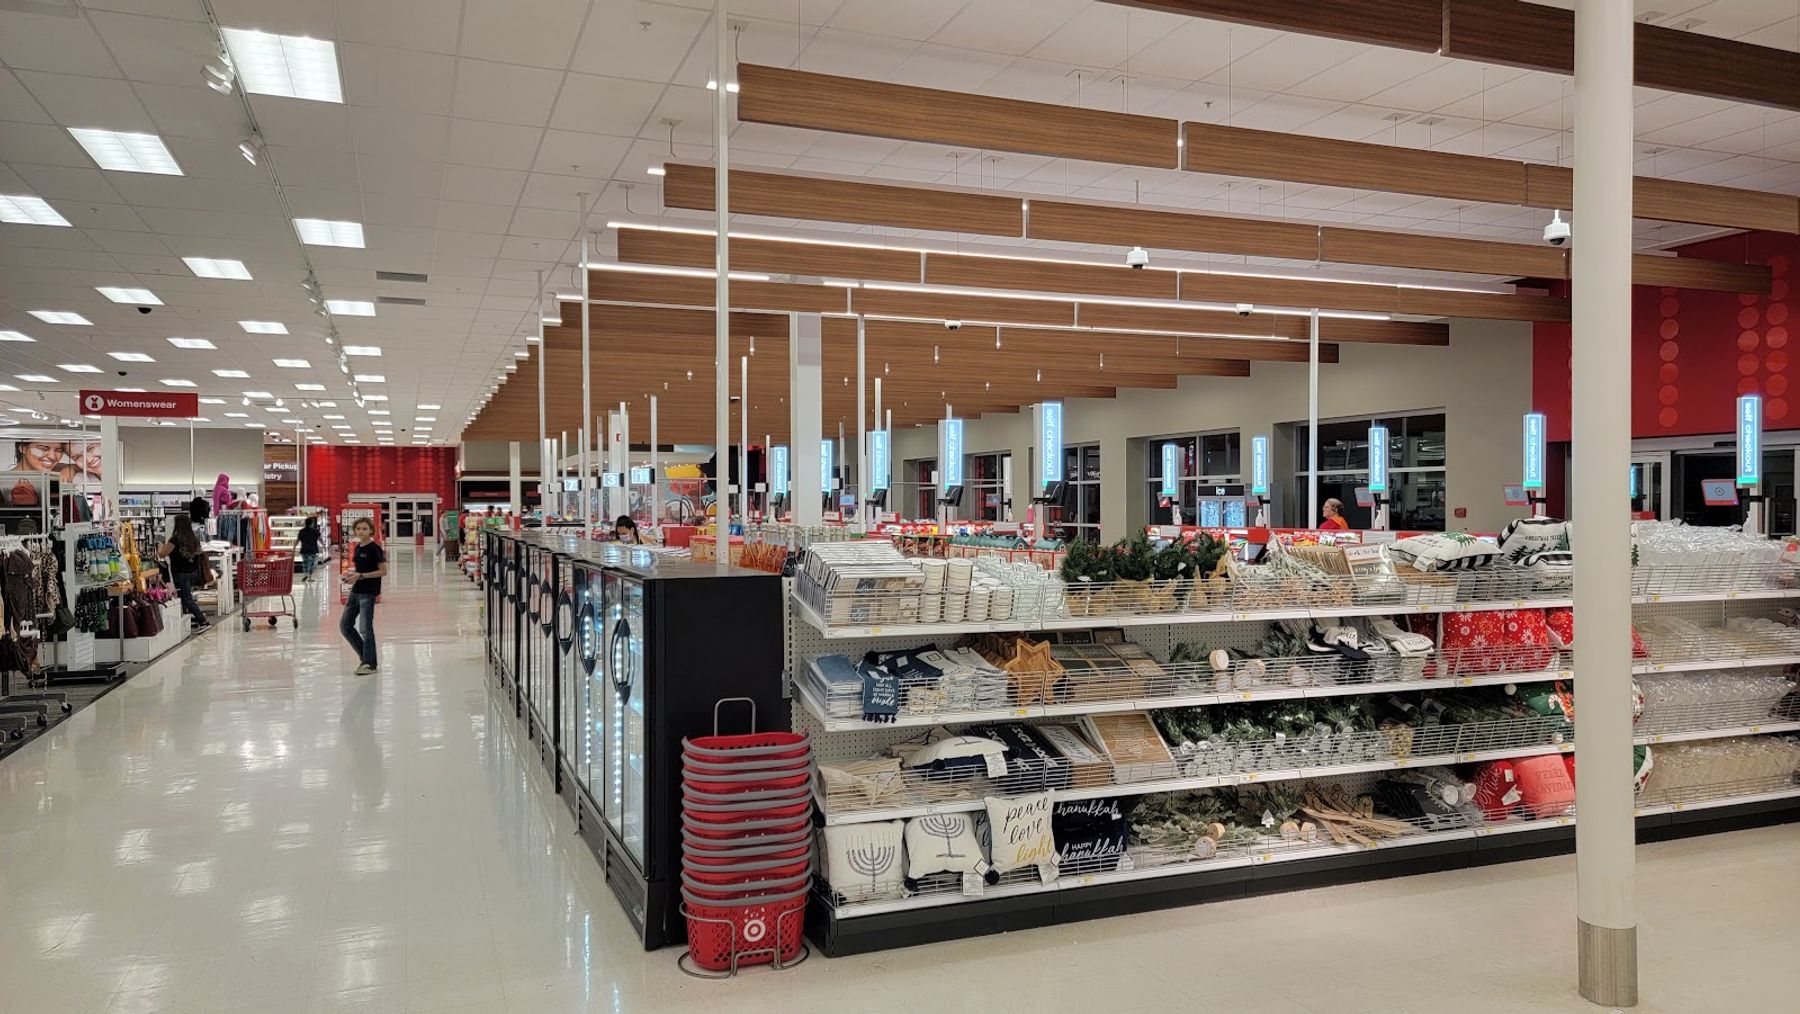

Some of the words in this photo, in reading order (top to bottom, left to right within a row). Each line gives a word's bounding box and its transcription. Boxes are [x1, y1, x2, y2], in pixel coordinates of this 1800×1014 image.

[107, 399, 176, 409] Womenswear
[1745, 402, 1753, 421] self
[1047, 408, 1055, 427] self
[1046, 430, 1055, 476] checkout
[1745, 424, 1753, 473] checkout
[273, 462, 299, 471] Pickup
[874, 452, 882, 485] checkout
[948, 442, 957, 480] checkout
[569, 480, 576, 489] 7
[607, 475, 615, 485] 3
[639, 474, 645, 482] 1
[1215, 486, 1226, 495] ice
[1003, 797, 1048, 834] peace
[1054, 799, 1120, 817] hanukkah
[1008, 818, 1043, 846] love
[1015, 833, 1053, 864] light
[1061, 835, 1124, 864] hanukkah
[1071, 841, 1093, 851] HAPPY
